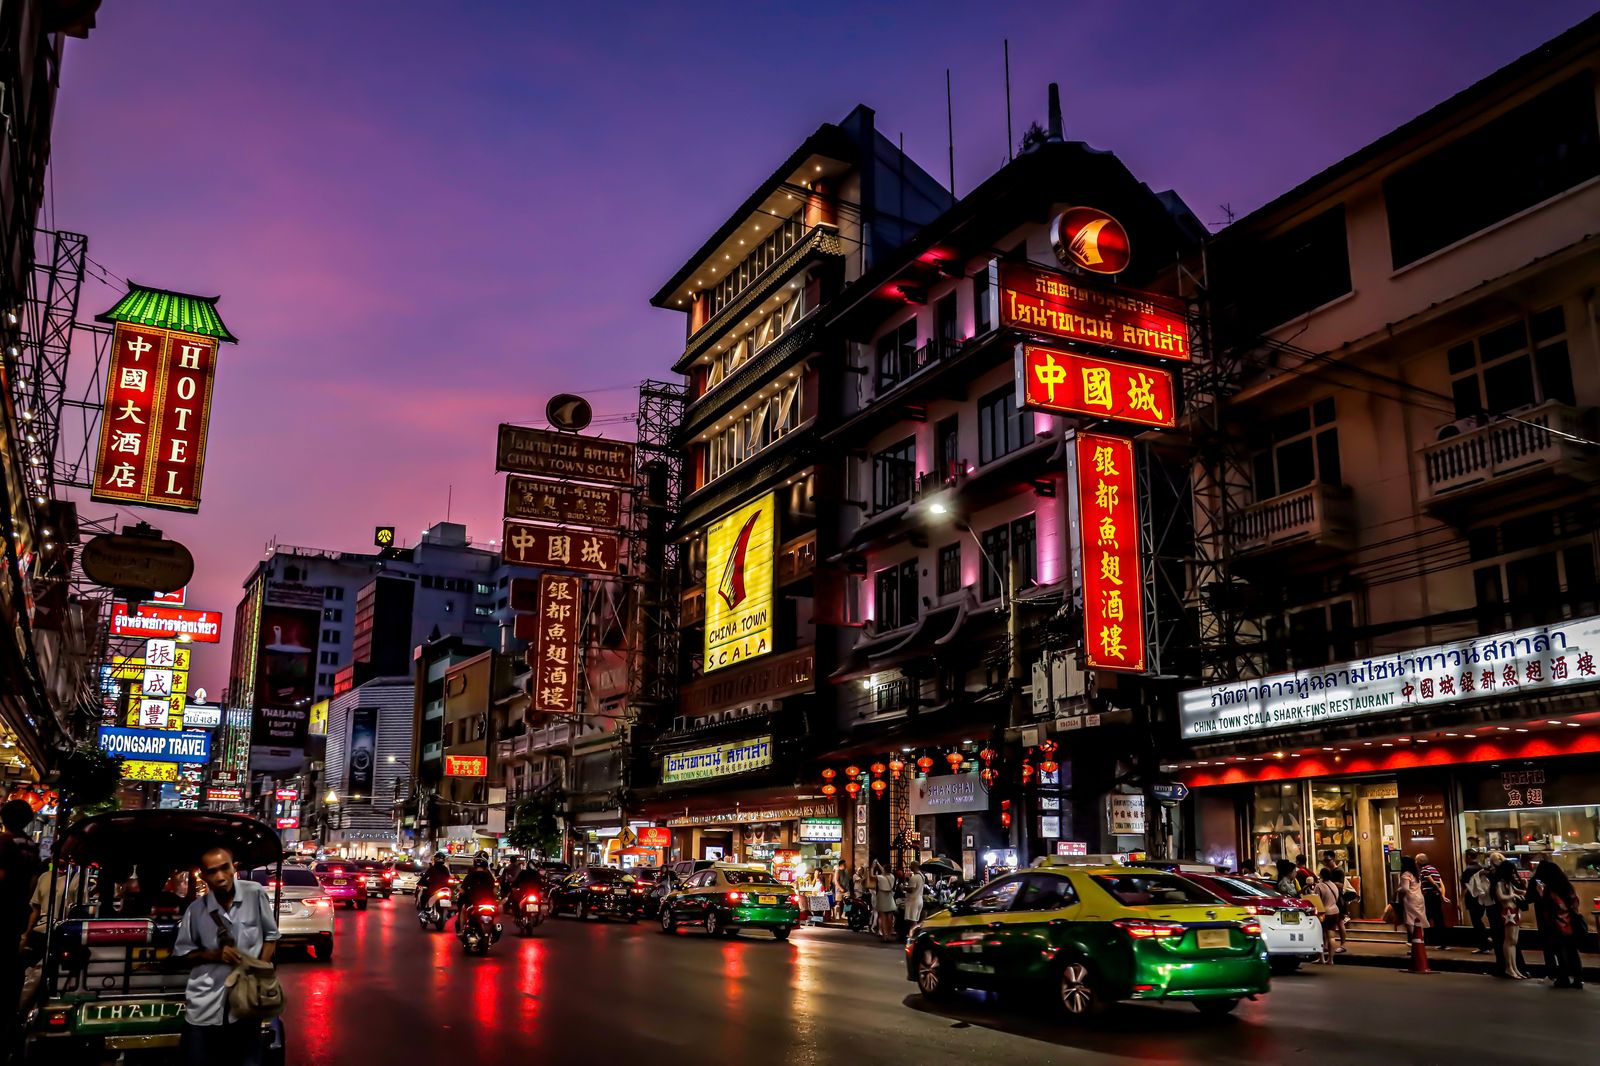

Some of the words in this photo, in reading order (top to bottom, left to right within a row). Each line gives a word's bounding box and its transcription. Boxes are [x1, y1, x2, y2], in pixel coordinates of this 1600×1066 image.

[1007, 289, 1112, 340] ไชน่าทาวน์
[1123, 323, 1184, 353] สกาล่า
[1035, 353, 1163, 420] 中國城
[105, 335, 153, 489] 中國大酒店
[164, 344, 203, 496] HOTEL
[507, 452, 545, 467] CHINA
[549, 458, 584, 473] TOWN
[587, 463, 626, 478] SCALA
[511, 528, 607, 570] 中國城
[1091, 445, 1127, 661] 銀都魚翅酒樓
[540, 581, 573, 707] 銀都魚翅酒樓
[709, 621, 737, 643] CHINA
[741, 609, 767, 629] TOWN
[708, 638, 766, 669] SCALA
[145, 643, 173, 725] 振成豐
[1401, 651, 1597, 703] 中國城銀都魚翅酒樓
[260, 707, 306, 719] THAILAND
[1194, 719, 1217, 733] CHINA
[1219, 716, 1241, 729] TOWN
[1243, 711, 1271, 726] SCALA
[1274, 702, 1326, 722] SHARK-FINS
[1329, 692, 1395, 713] RESTAURANT
[101, 734, 166, 754] ROONGSARP
[169, 738, 207, 756] TRAVEL
[666, 747, 721, 772] ไชน่าทาวน์
[727, 738, 768, 763] สกาล่า
[696, 769, 713, 778] SCALA
[928, 782, 974, 797] SHANGHAI
[1508, 788, 1543, 806] 魚翅
[97, 1003, 187, 1019] THAILA
